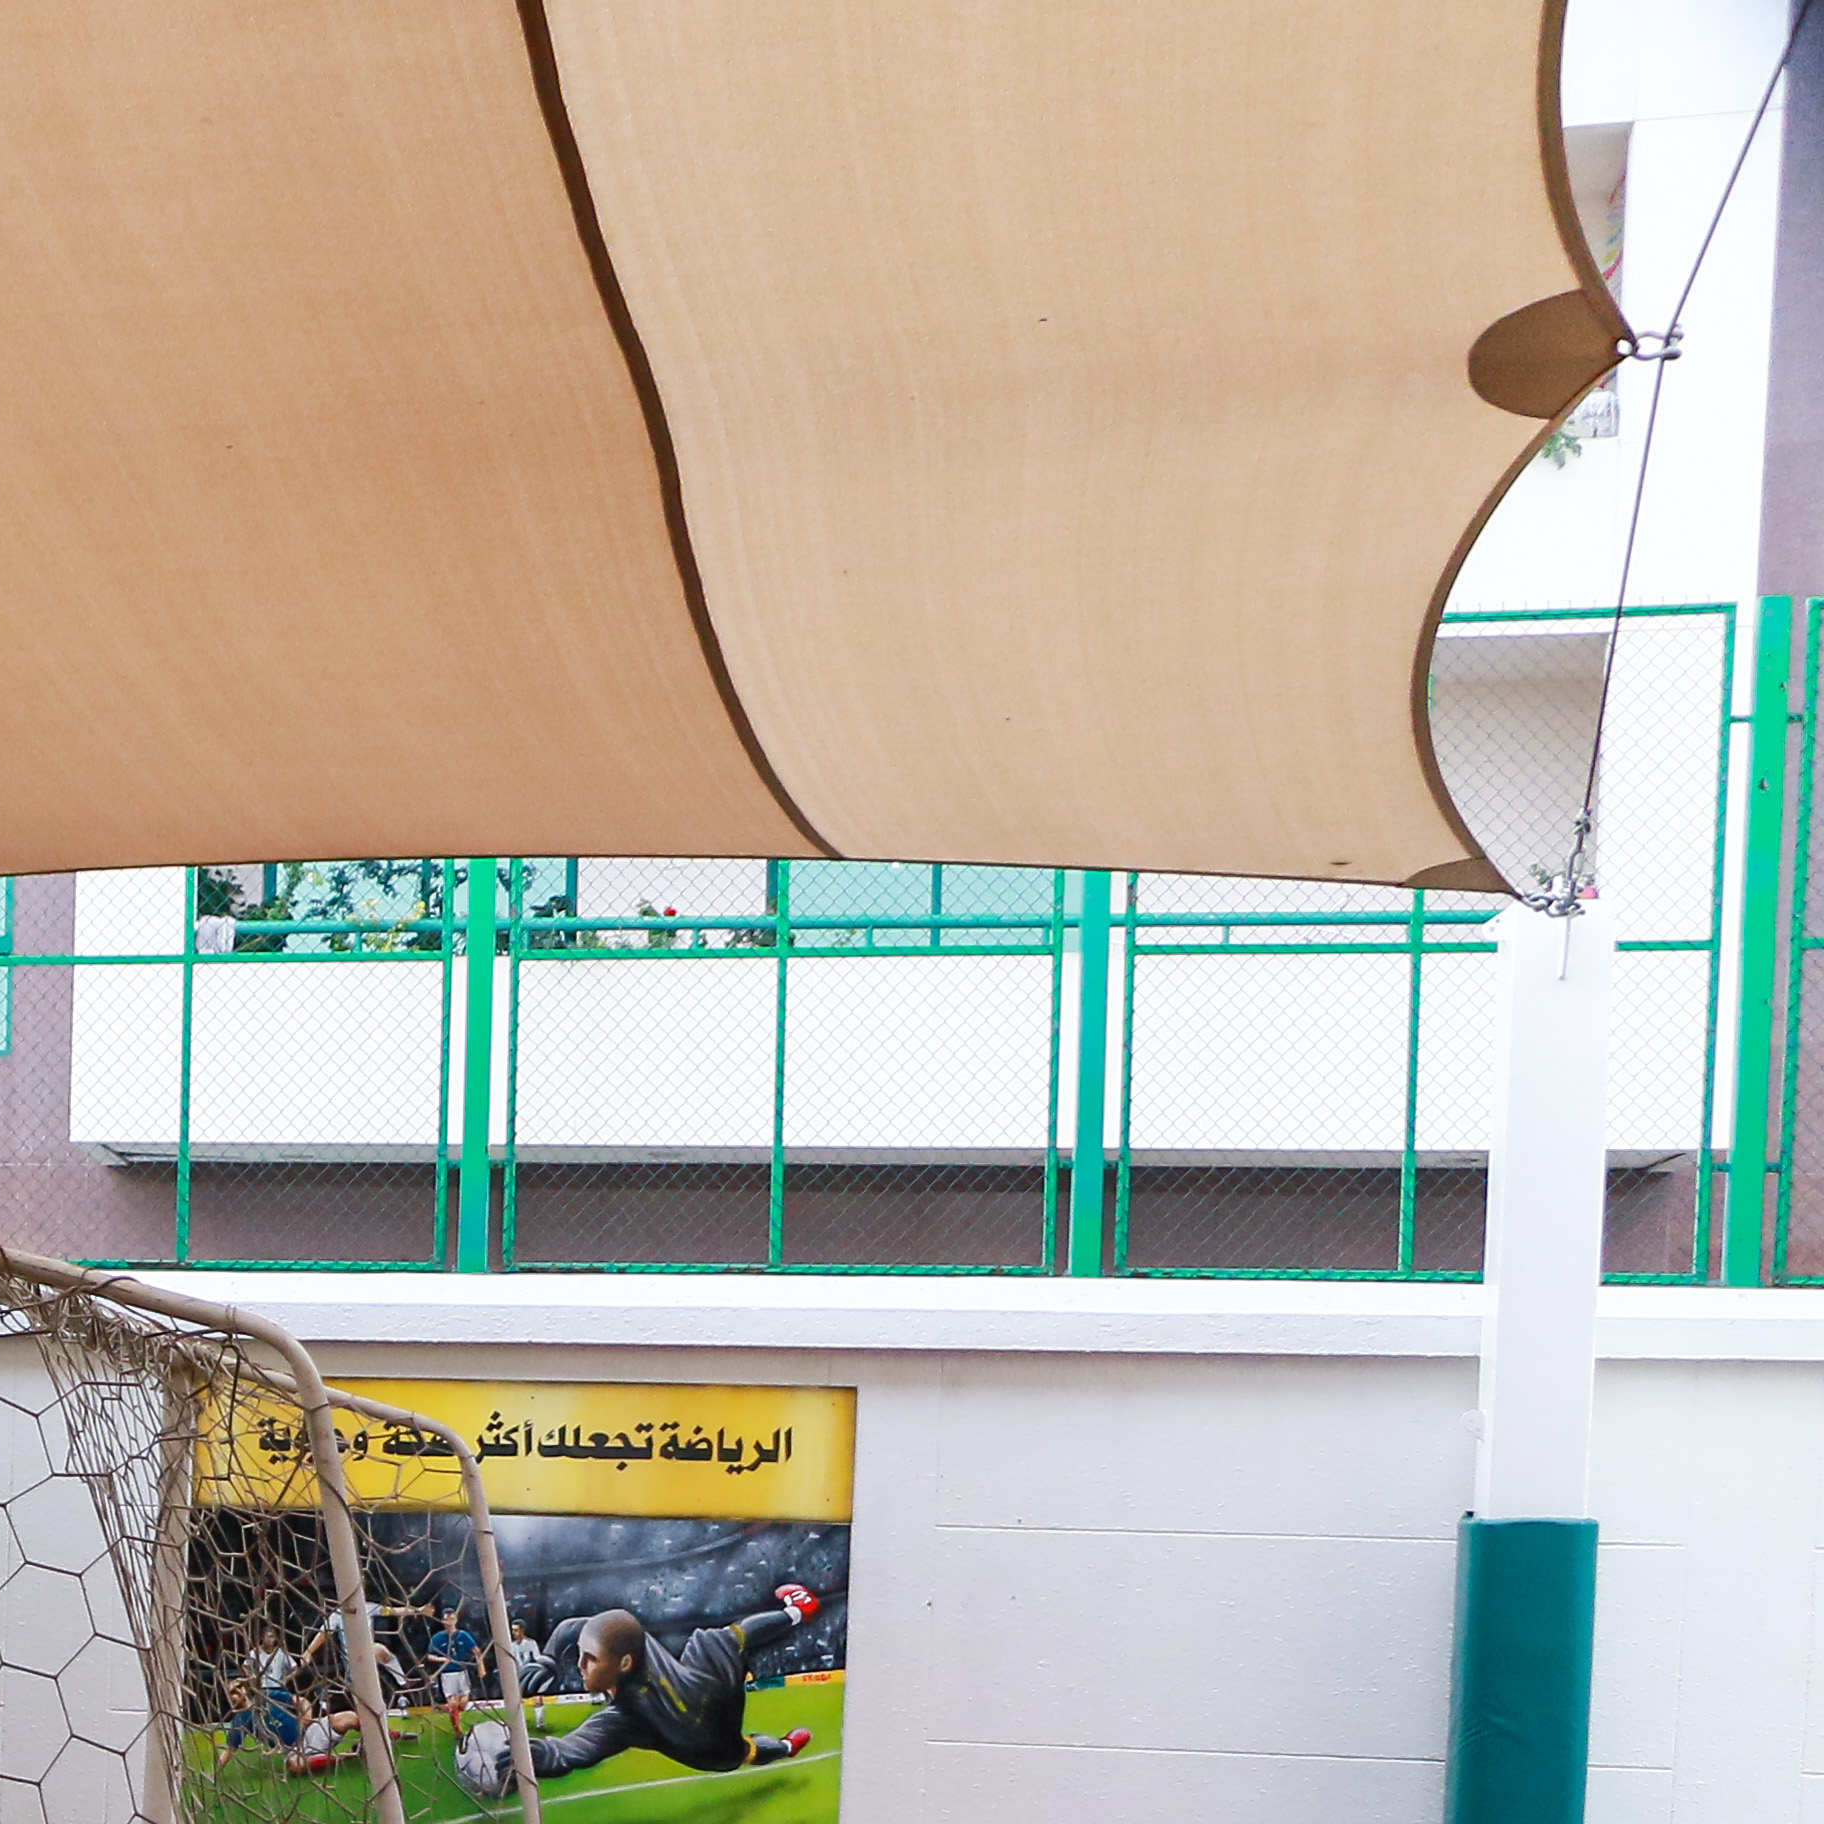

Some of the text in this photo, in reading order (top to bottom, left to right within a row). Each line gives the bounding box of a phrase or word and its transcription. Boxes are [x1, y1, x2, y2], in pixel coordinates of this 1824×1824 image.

[474, 1410, 534, 1465] أكثر
[537, 1422, 654, 1471] تجعلك
[659, 1421, 793, 1475] الرياضة
